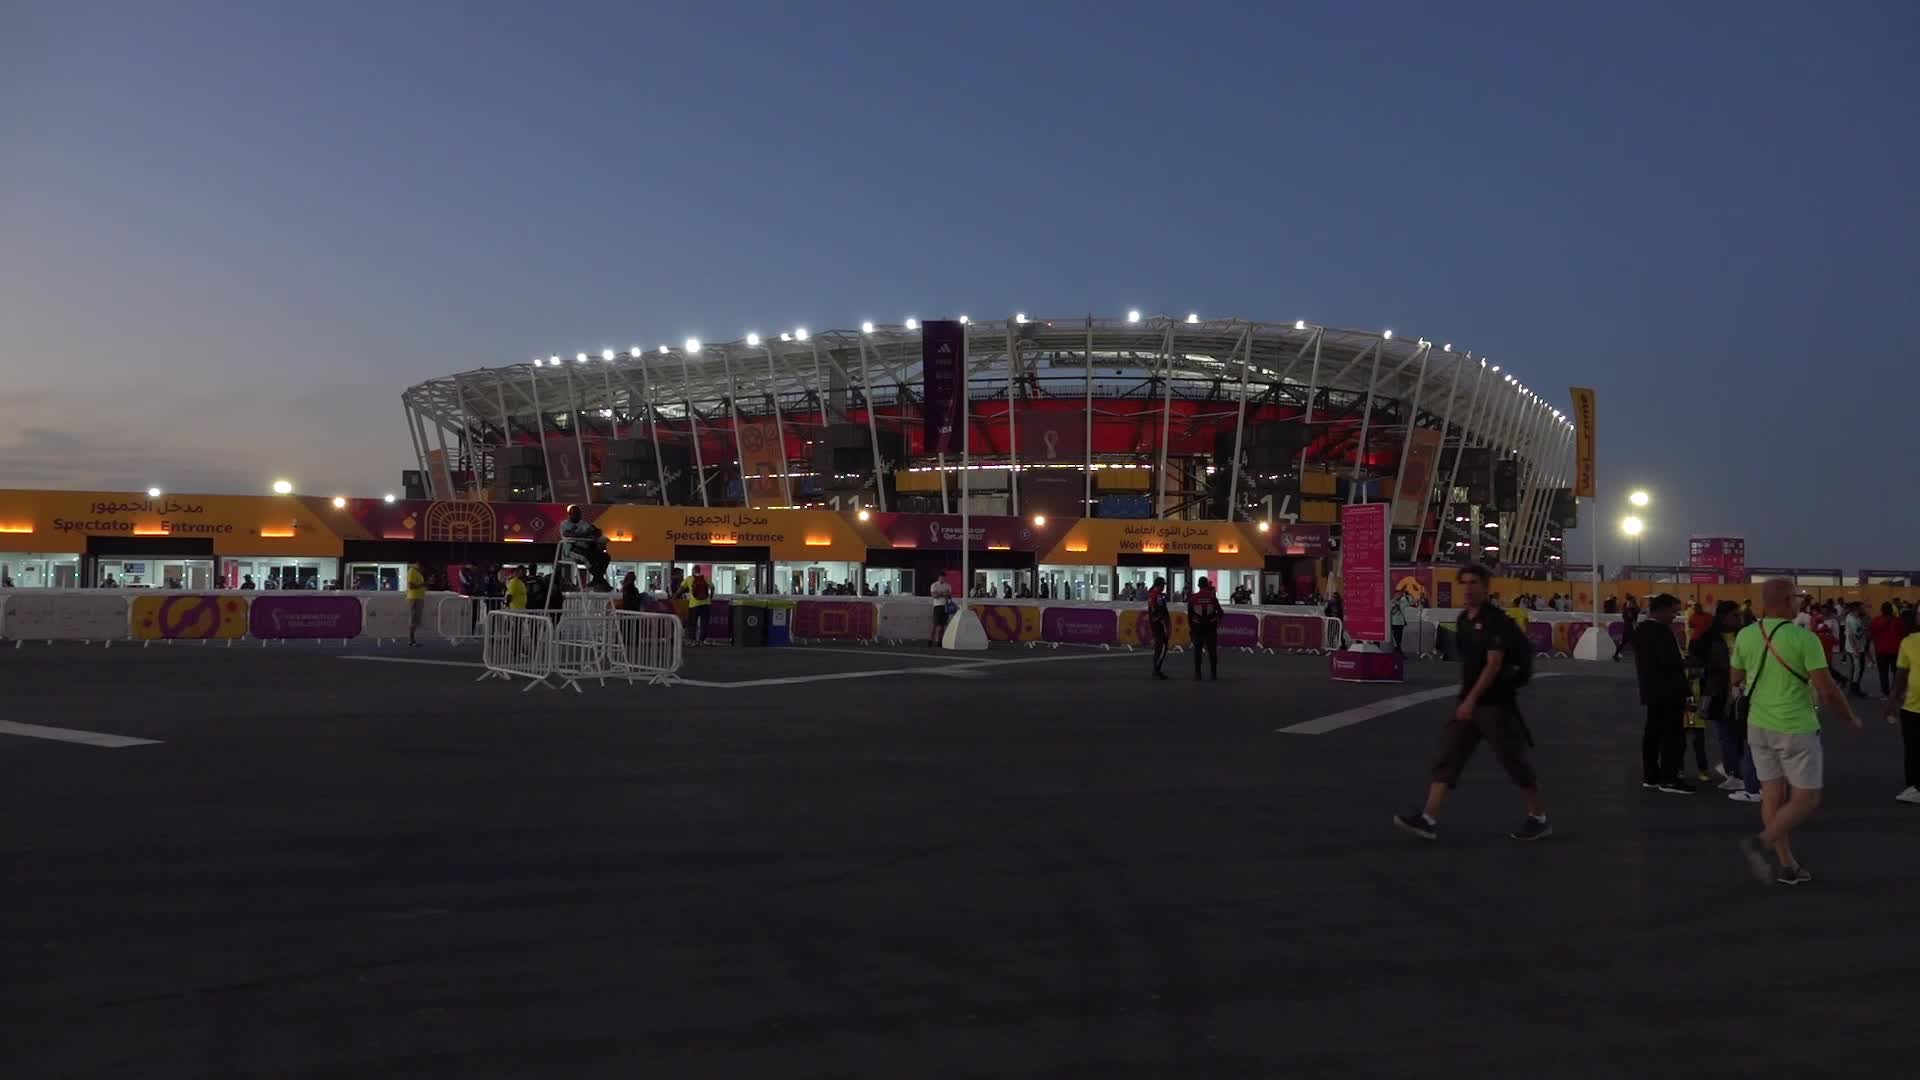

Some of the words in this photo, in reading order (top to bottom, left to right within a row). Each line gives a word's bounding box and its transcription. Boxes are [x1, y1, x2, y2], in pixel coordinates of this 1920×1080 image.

[157, 500, 205, 515] مدخل
[1260, 494, 1298, 524] 14
[53, 518, 137, 533] Spectator
[160, 520, 233, 533] Entrance
[684, 514, 730, 527] الجمهور
[733, 513, 768, 527] مدخل
[665, 529, 729, 543] Spectator
[731, 531, 784, 542] Entrance
[1119, 540, 1170, 550] Workforce
[1172, 541, 1213, 550] Entrance
